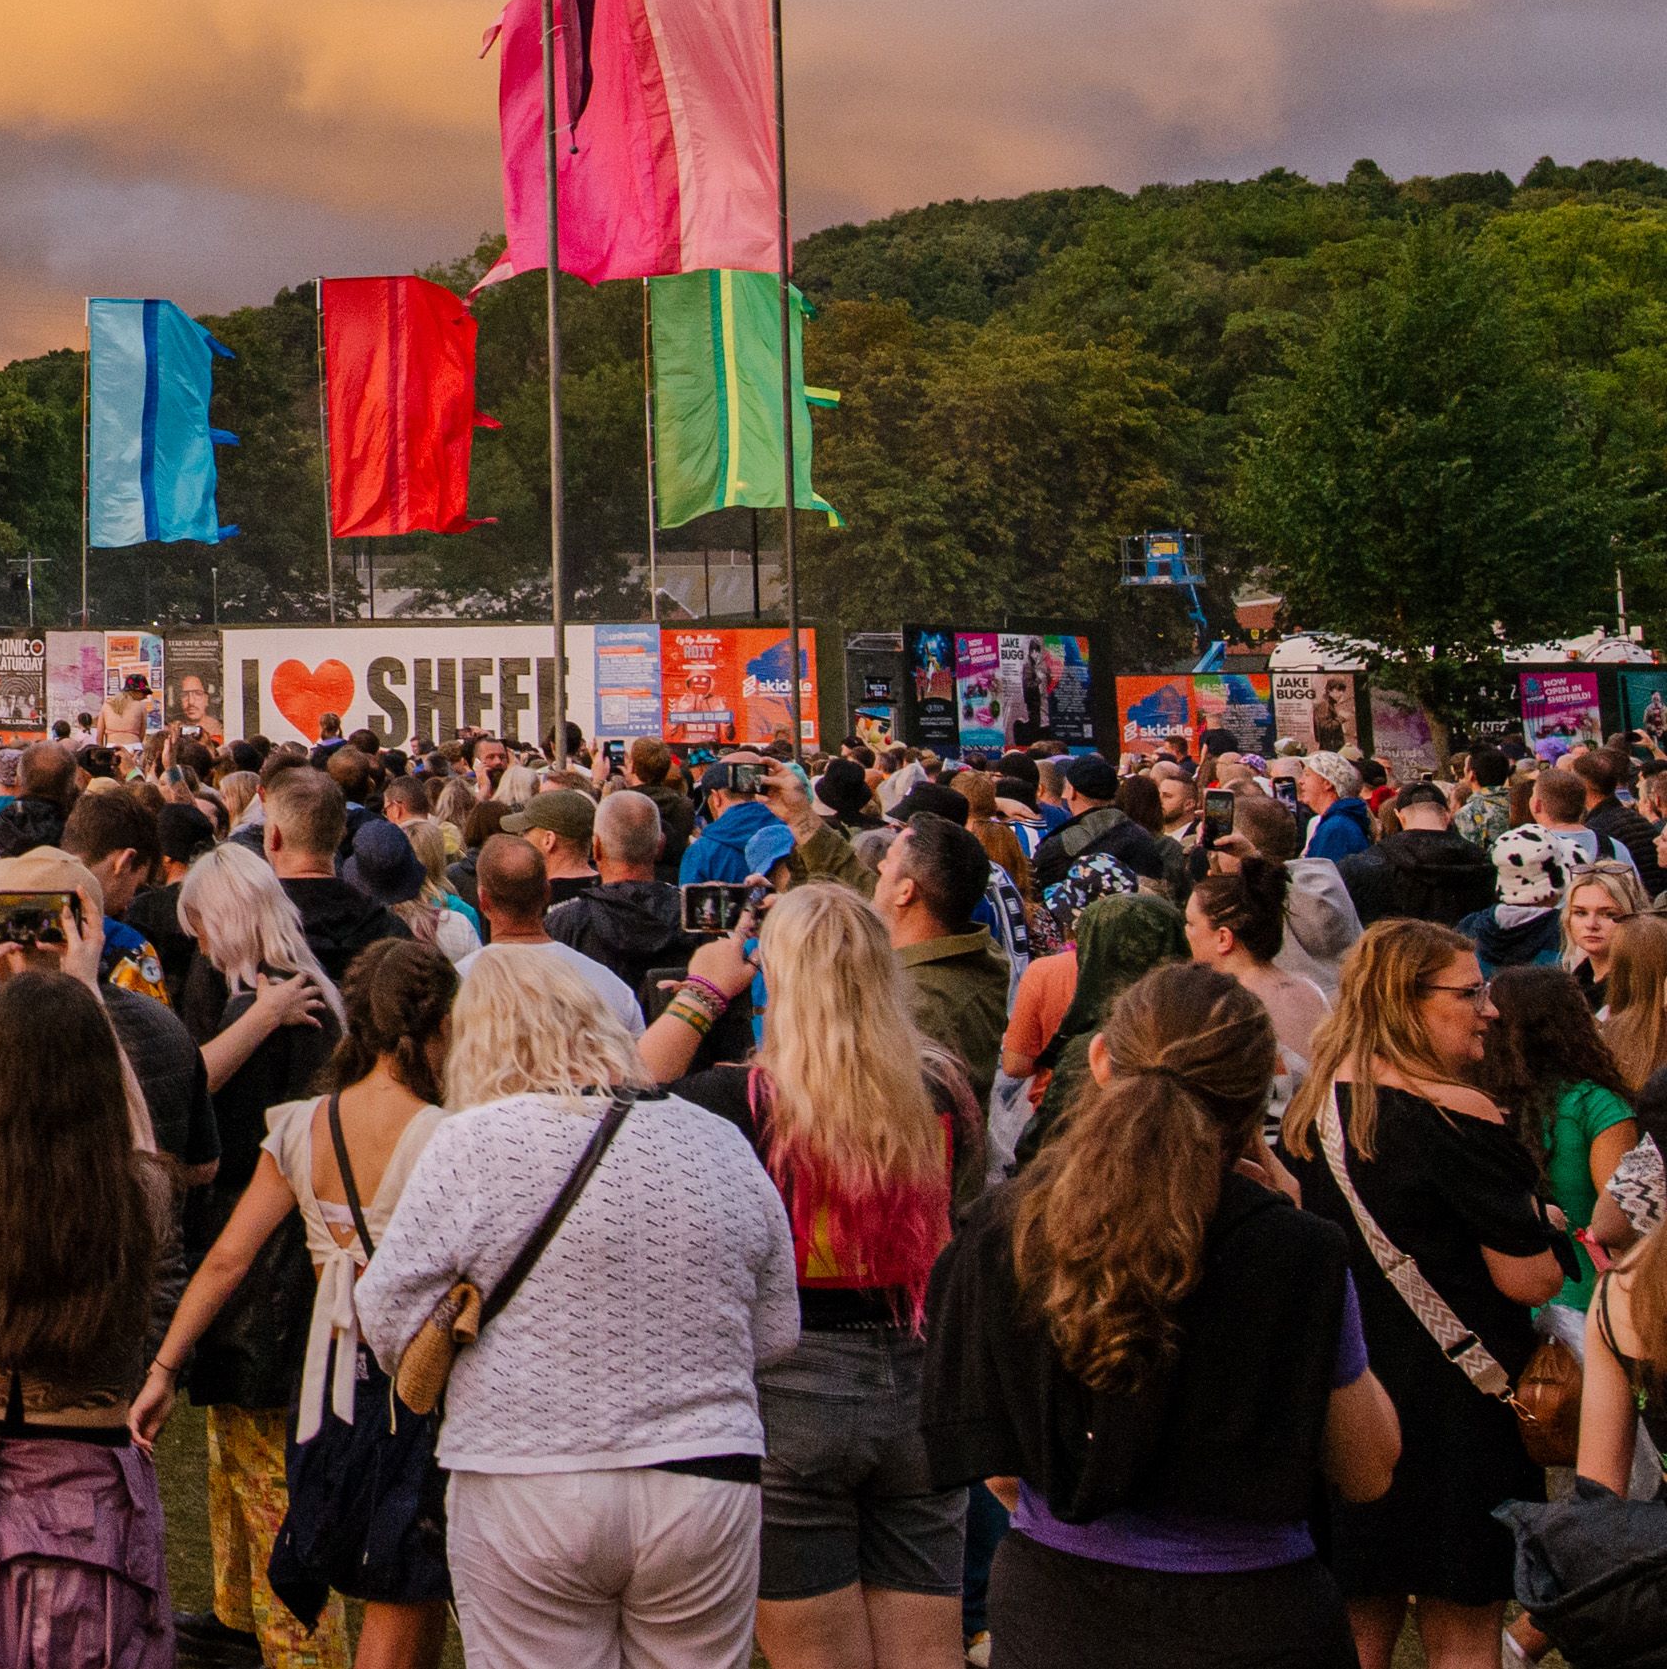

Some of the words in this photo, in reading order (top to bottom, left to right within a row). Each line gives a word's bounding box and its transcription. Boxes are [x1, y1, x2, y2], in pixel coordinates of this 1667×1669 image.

[1000, 637, 1020, 649] JAKE
[683, 645, 715, 660] ROXY
[1000, 649, 1025, 661] BUGG
[758, 678, 813, 693] skidle
[1276, 677, 1310, 689] JAKE
[1543, 677, 1567, 688] NOW
[1276, 688, 1317, 700] BUGG
[1545, 686, 1570, 696] OPEN
[1571, 683, 1583, 693] IN
[241, 659, 260, 740] I
[1139, 723, 1194, 738] skiddle
